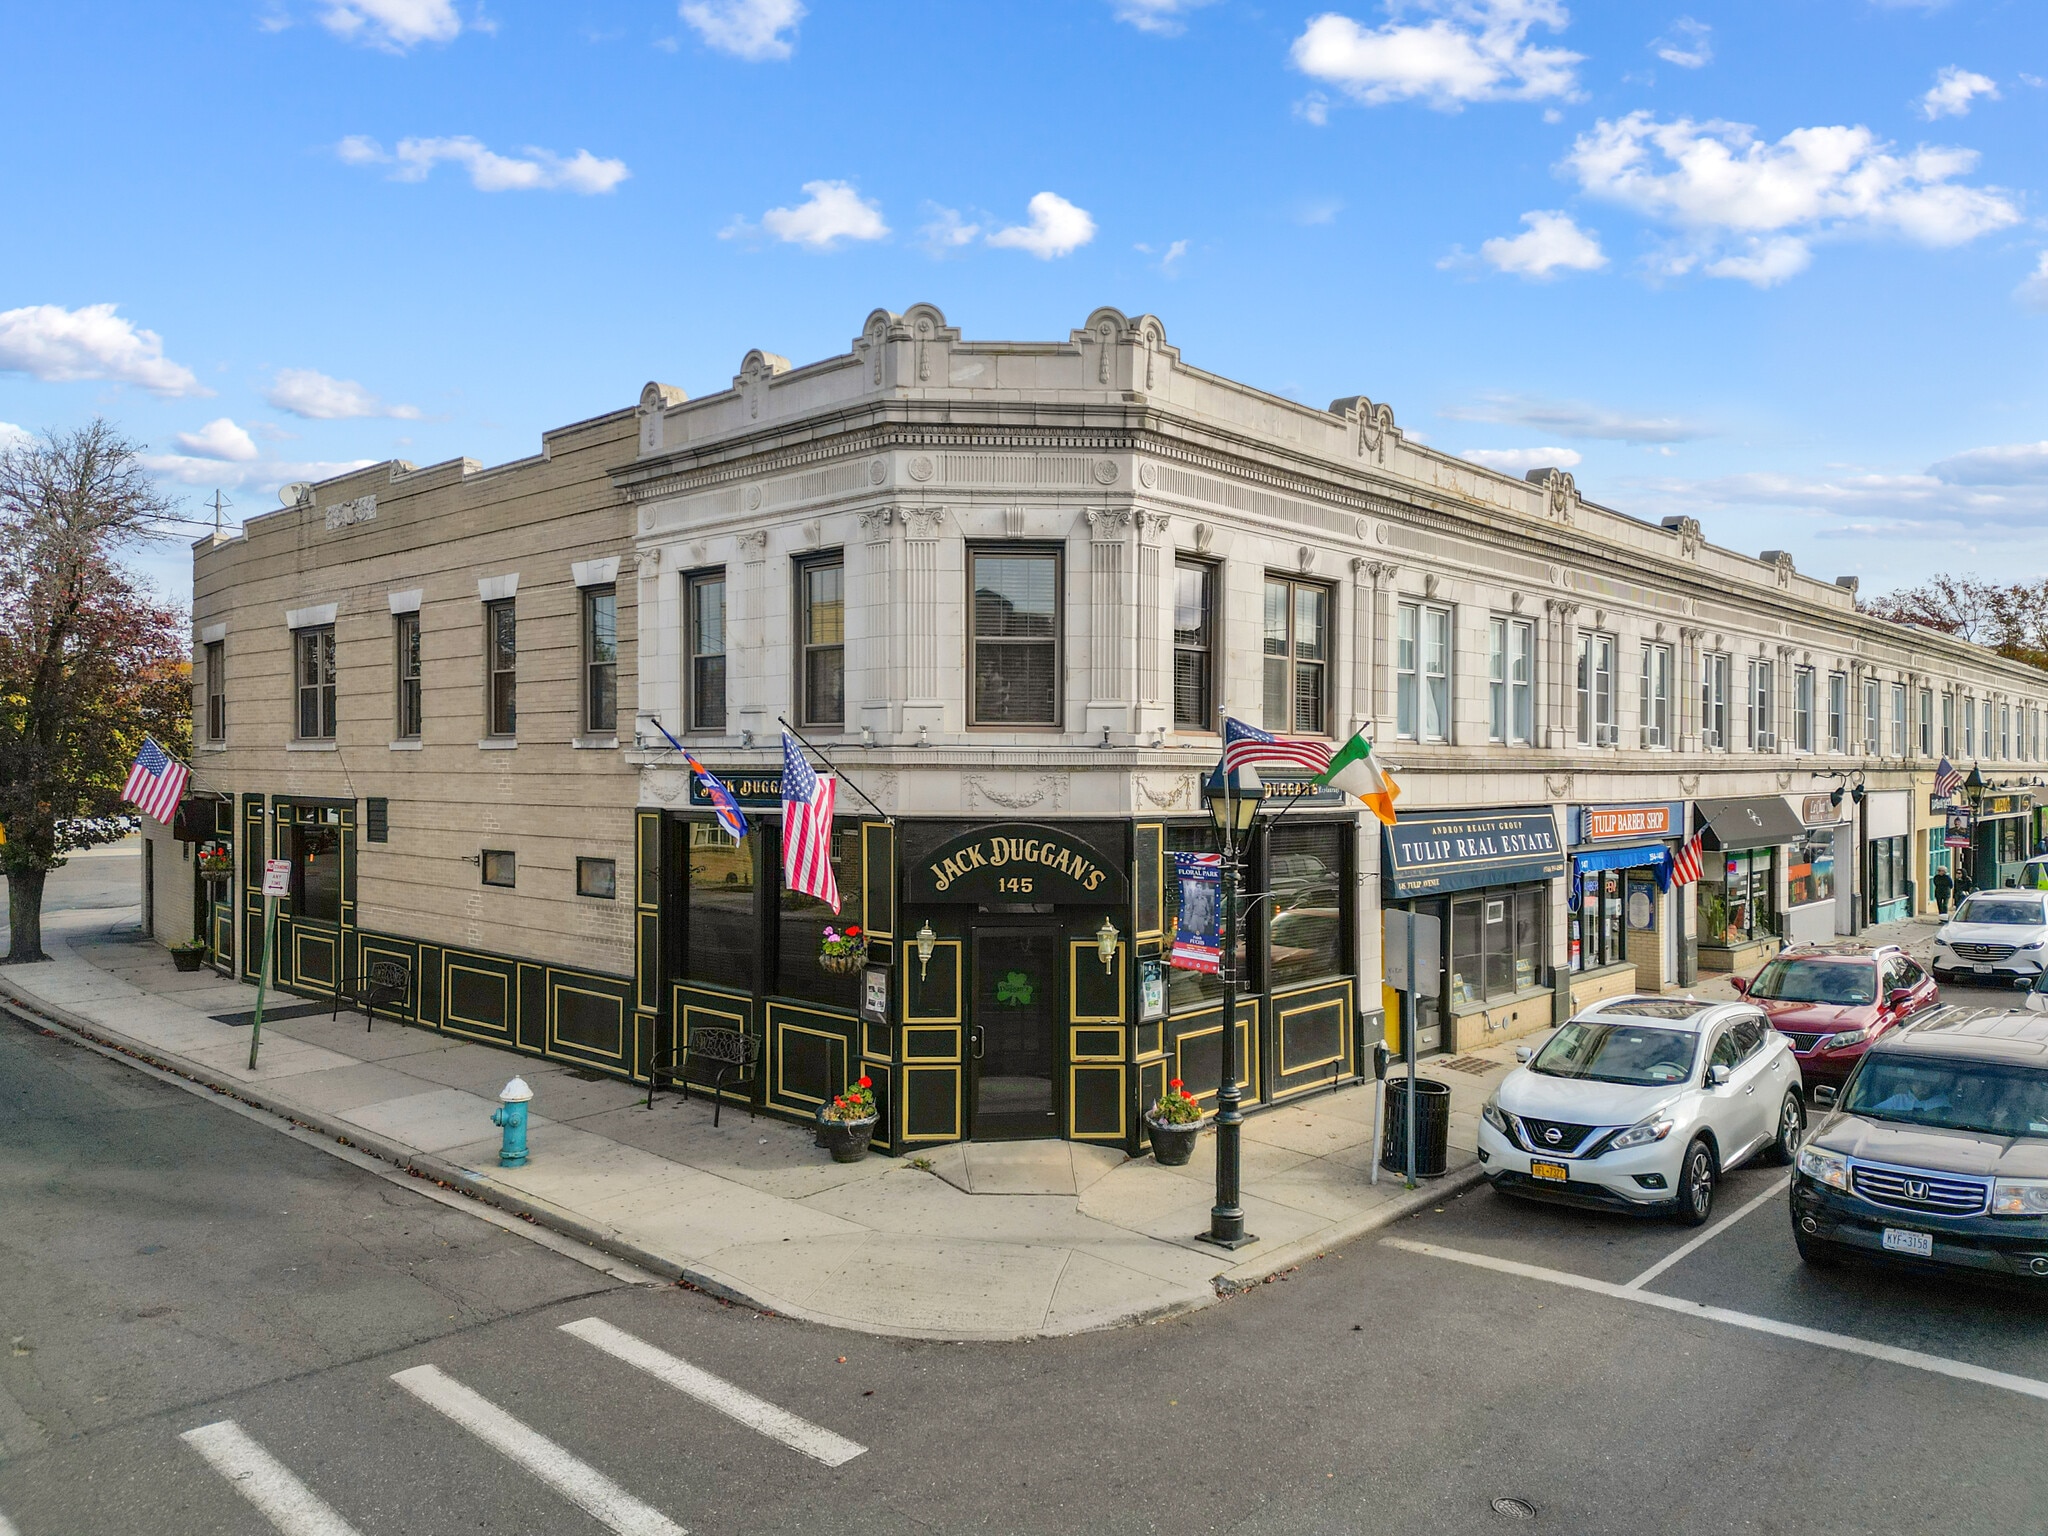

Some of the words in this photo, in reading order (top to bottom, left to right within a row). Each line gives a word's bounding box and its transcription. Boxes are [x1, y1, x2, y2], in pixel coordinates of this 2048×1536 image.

[1432, 825, 1463, 835] ANDRON
[1467, 823, 1496, 833] REALTY
[1499, 821, 1522, 830] GROUP
[1594, 814, 1617, 833] TULIP
[1618, 813, 1645, 831] BARBER
[1647, 812, 1664, 829] SHOP
[1402, 840, 1451, 862] TULIP
[1456, 836, 1497, 857] REAL
[1501, 832, 1553, 853] ESTATE
[930, 843, 988, 891] JACK
[990, 836, 1107, 891] DUGGAN'S
[999, 877, 1034, 893] 145
[1407, 880, 1422, 889] TULIP
[1887, 1233, 1928, 1250] KYF-3158
